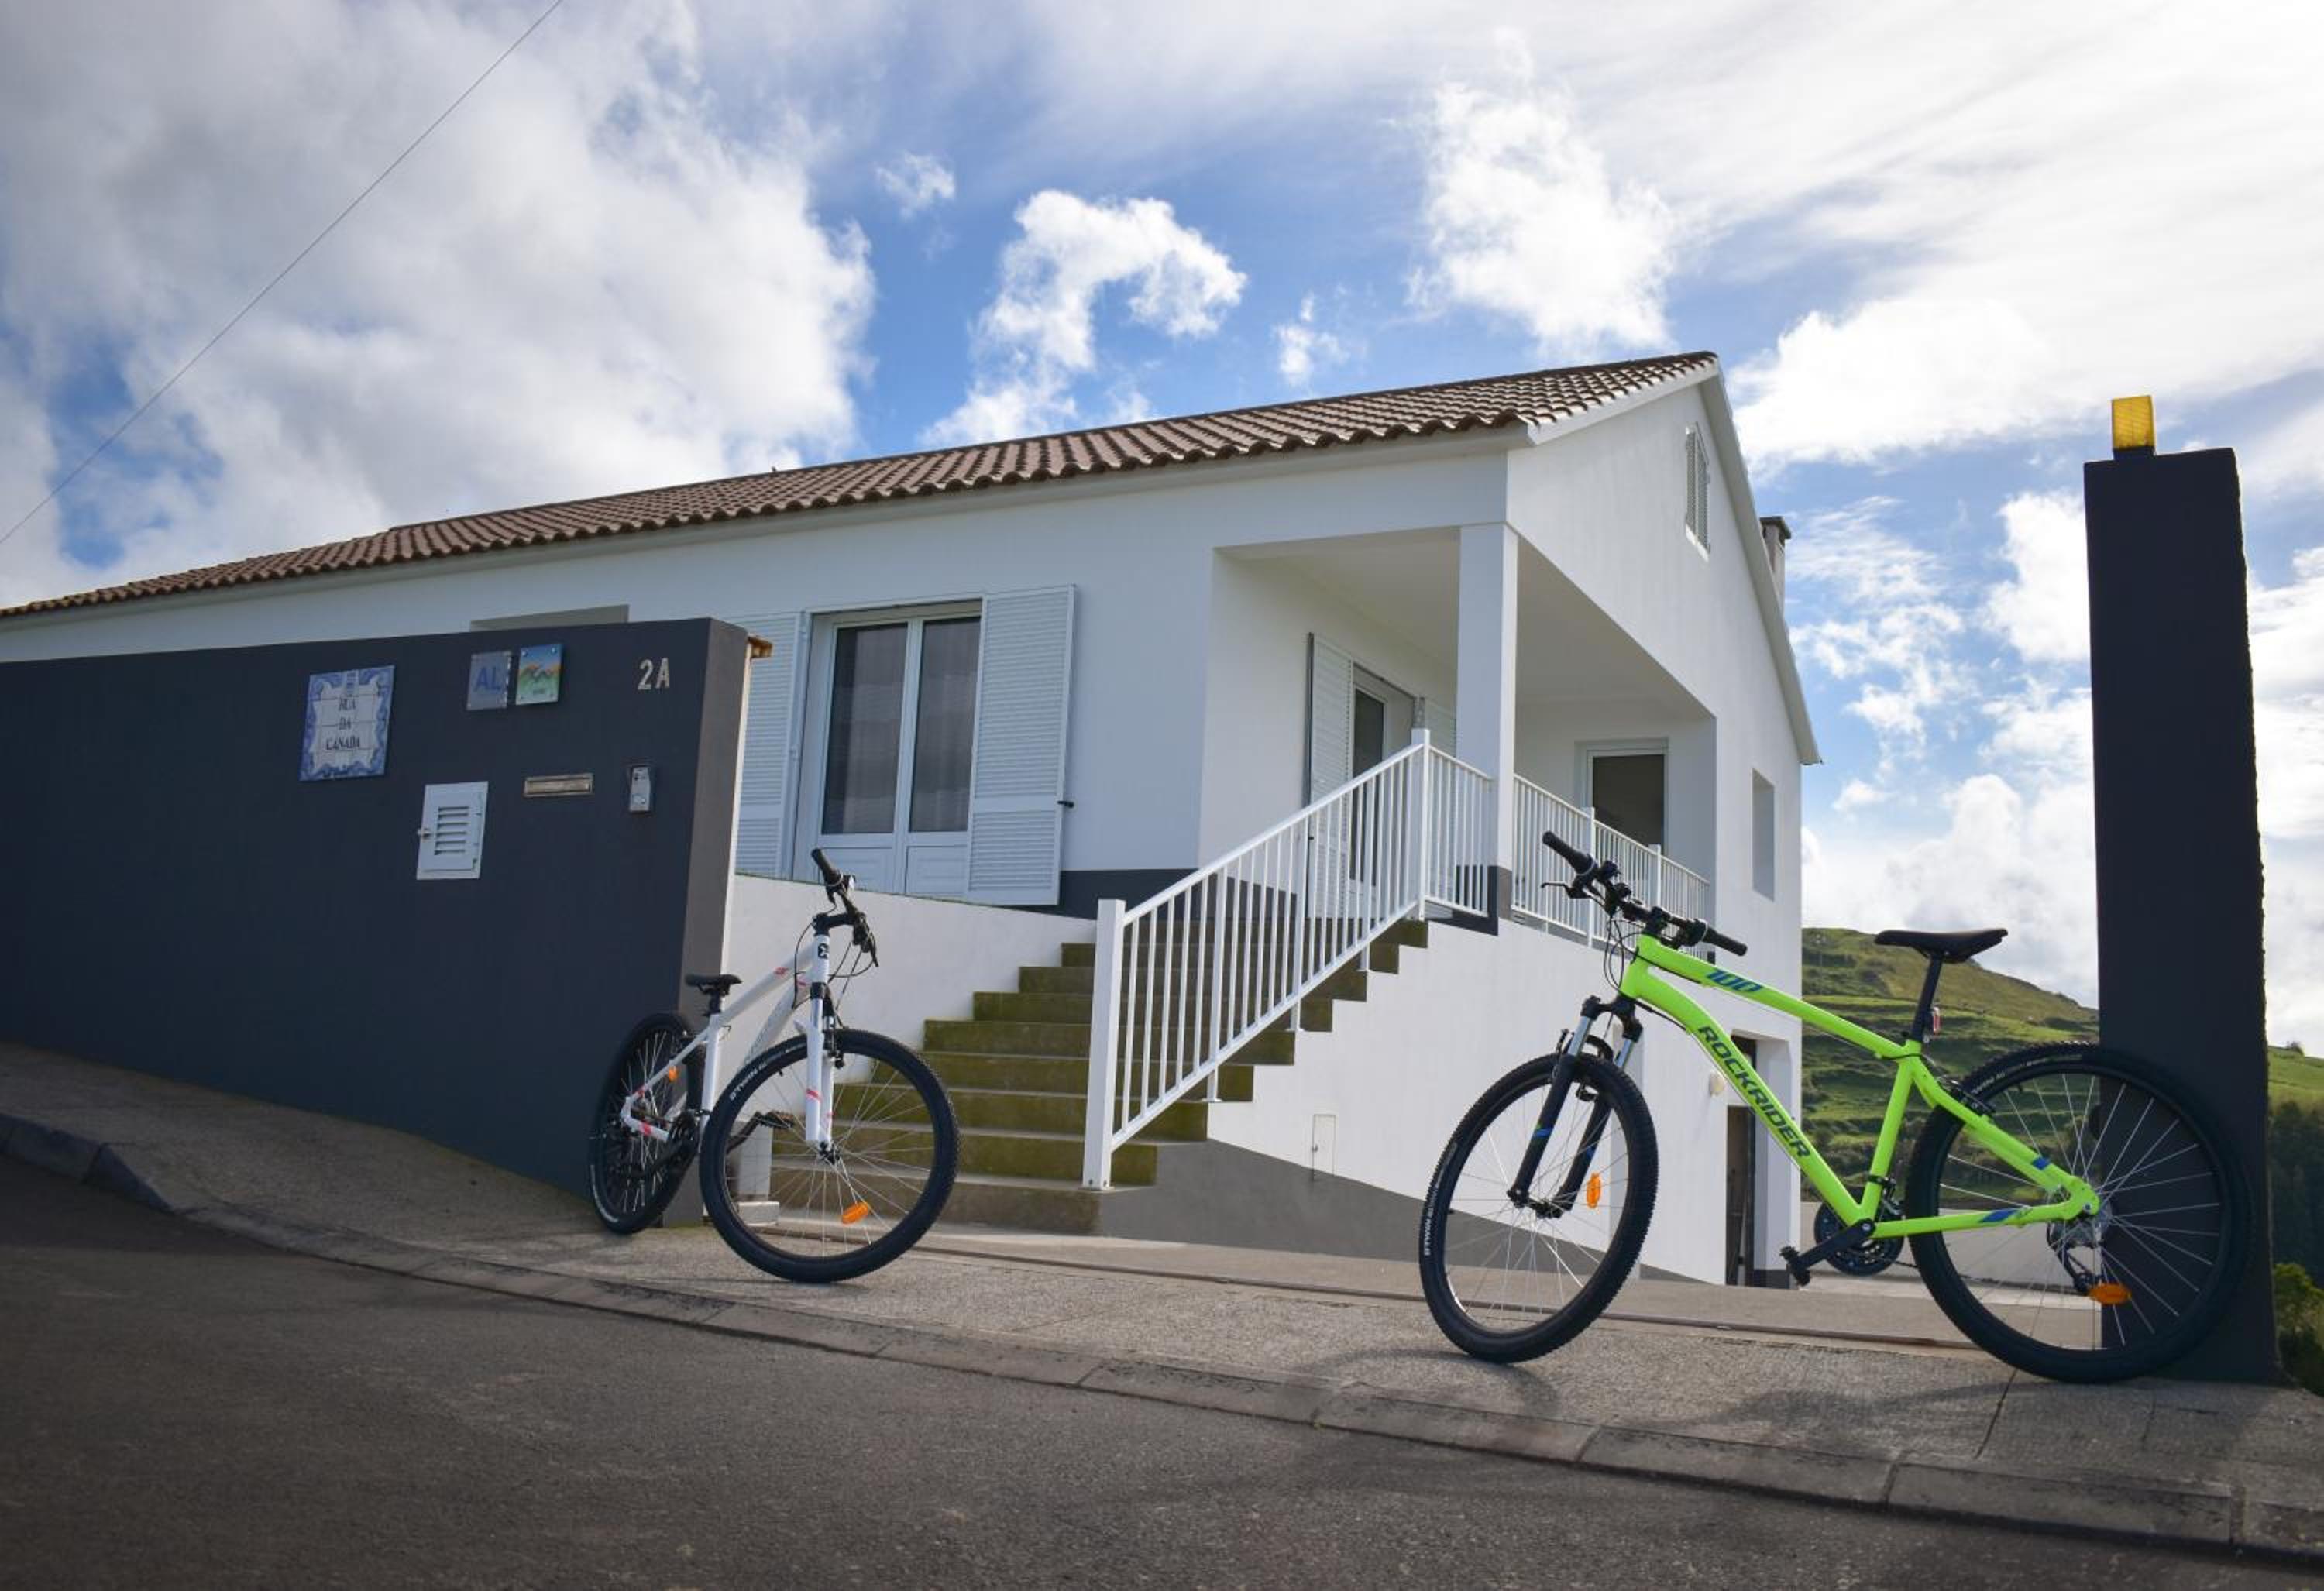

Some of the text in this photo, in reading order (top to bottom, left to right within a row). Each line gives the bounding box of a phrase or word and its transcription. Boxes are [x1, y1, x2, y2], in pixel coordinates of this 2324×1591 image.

[473, 666, 502, 693] AL
[638, 658, 670, 690] 2A
[1706, 968, 1763, 993] 100
[1699, 1026, 1811, 1157] ROCKRIDER
